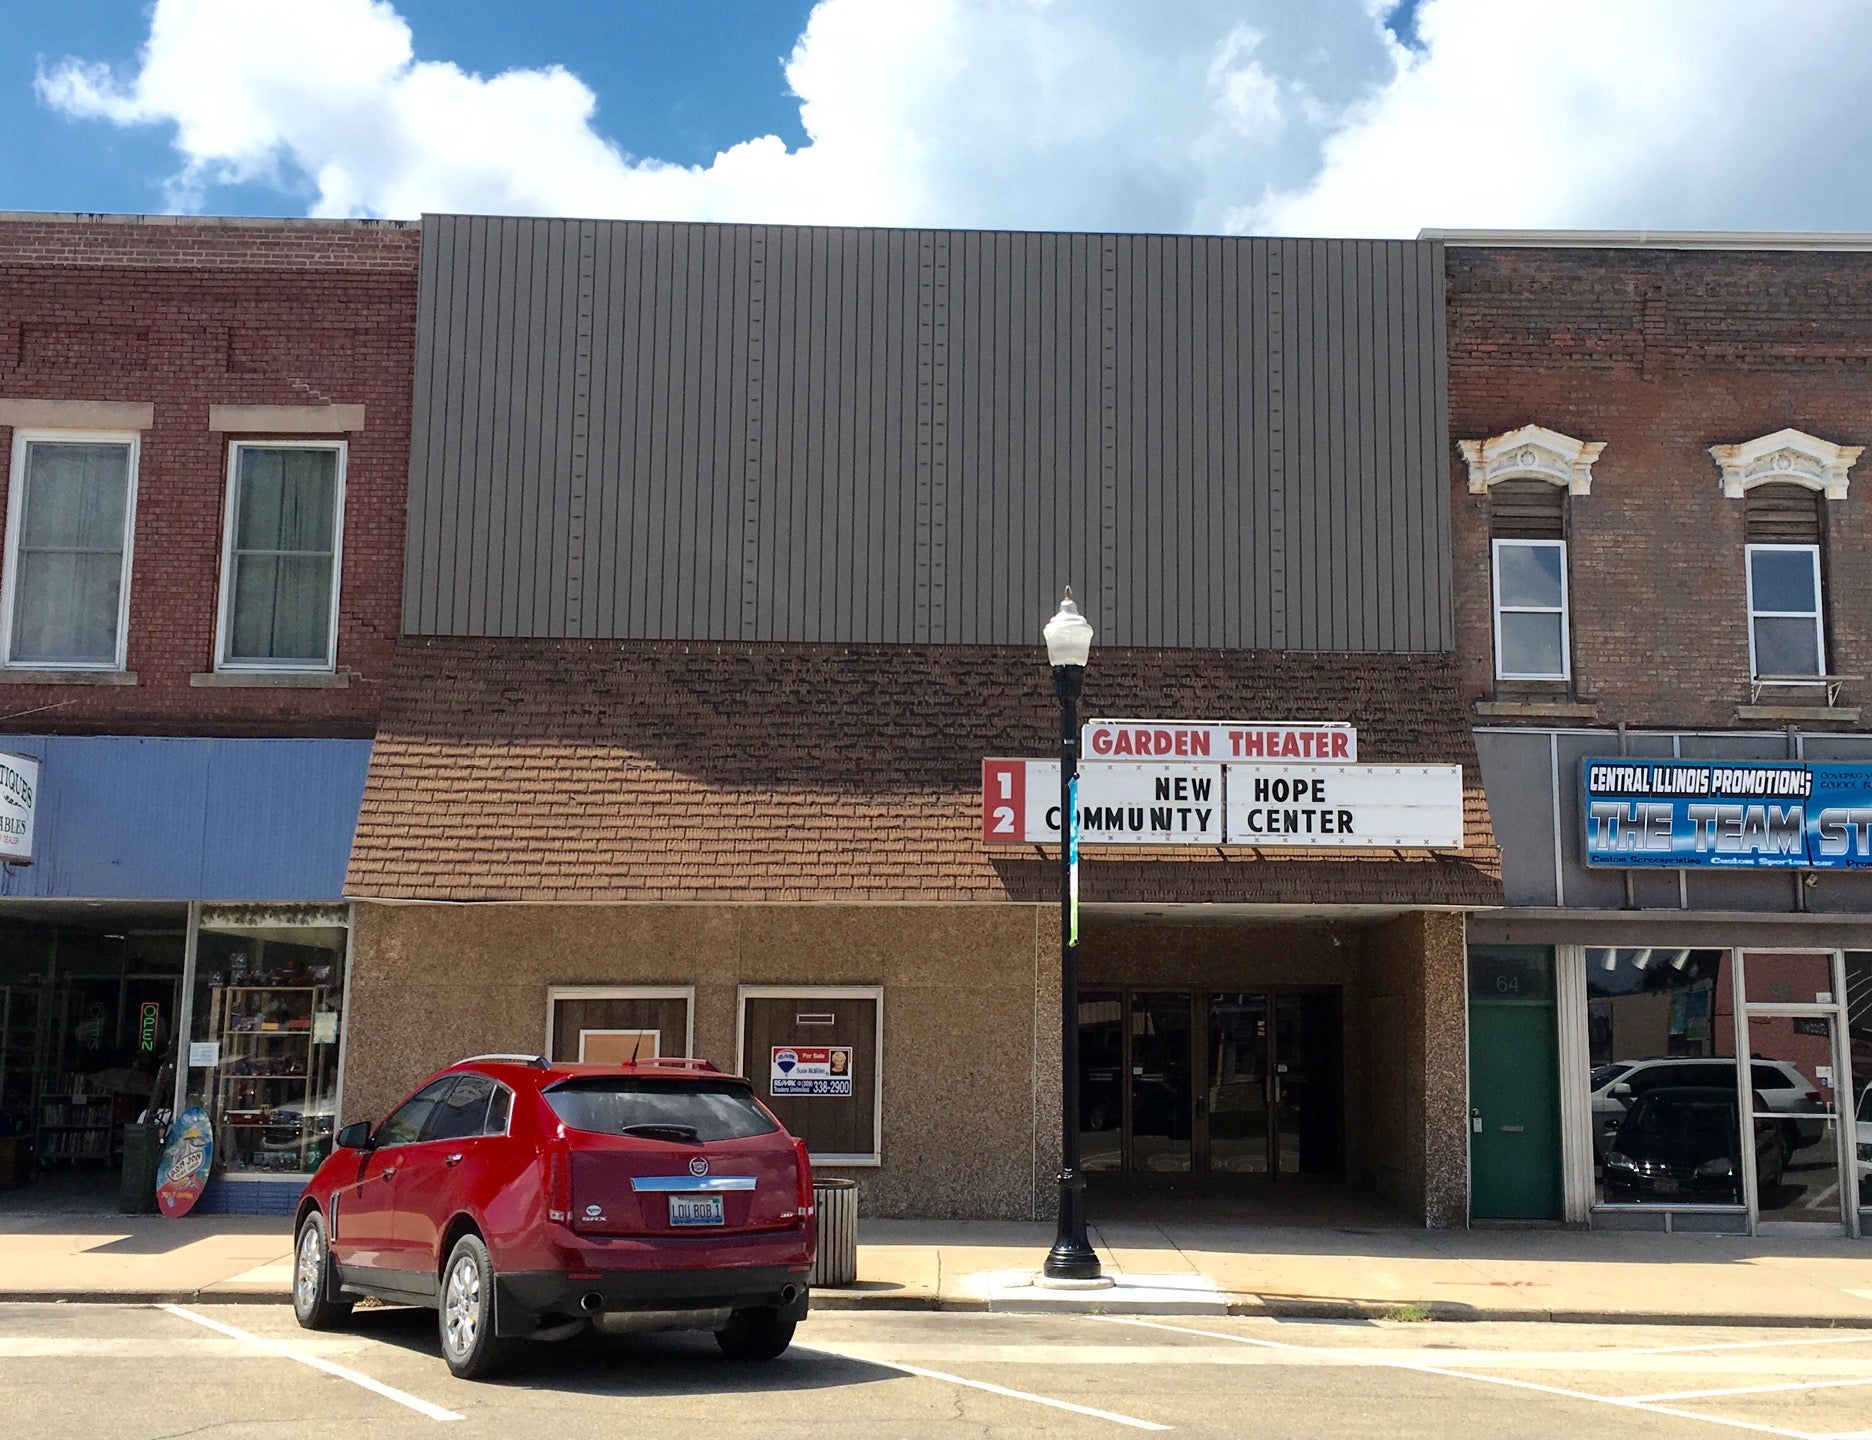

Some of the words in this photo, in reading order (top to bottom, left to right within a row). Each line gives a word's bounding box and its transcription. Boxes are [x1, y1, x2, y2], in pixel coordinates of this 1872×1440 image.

[1092, 729, 1210, 756] GARDEN
[1228, 731, 1349, 758] THEATER
[997, 772, 1012, 799] 1
[1155, 777, 1211, 801] NEW
[1254, 778, 1325, 802] HOPE
[1590, 767, 1650, 792] CENTRAL
[1652, 767, 1709, 794] ILLINOIS
[1711, 769, 1812, 796] PROMOTIONS
[992, 806, 1015, 833] 2
[1045, 806, 1212, 832] CMMUNITY
[1247, 808, 1354, 834] CENTER
[1590, 801, 1674, 852] THE
[1687, 803, 1803, 856] TEAM
[1818, 807, 1872, 856] ST
[1710, 857, 1754, 865] Custom
[1496, 975, 1519, 992] 64
[141, 1005, 156, 1051] OPEN
[813, 1081, 849, 1093] 338-2900
